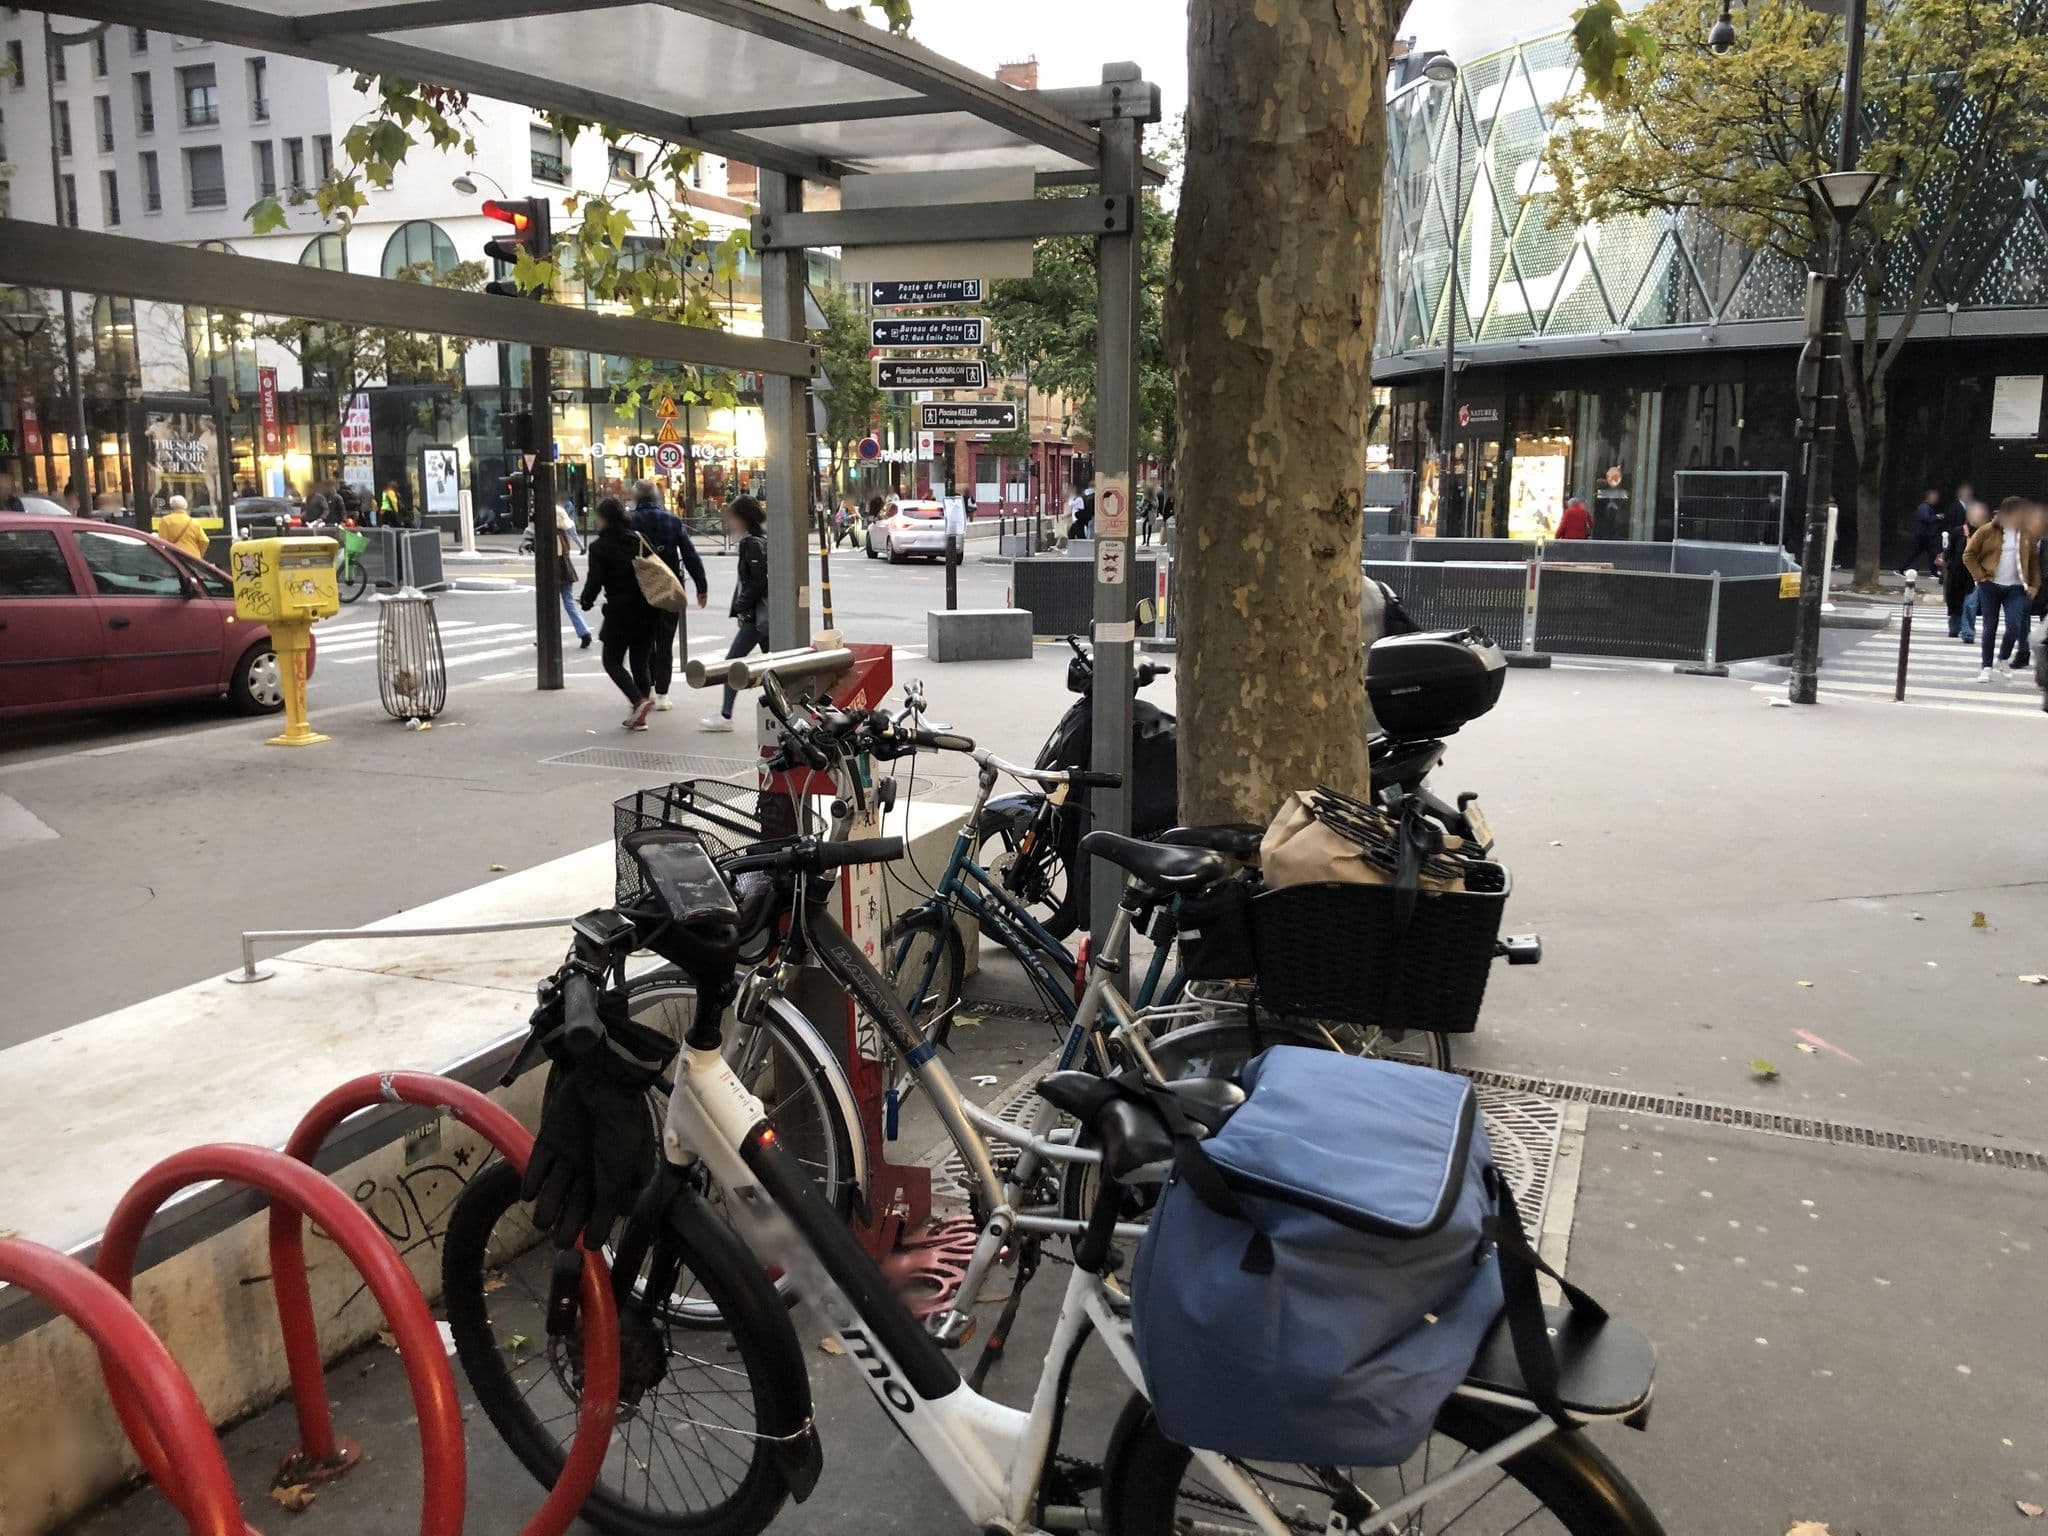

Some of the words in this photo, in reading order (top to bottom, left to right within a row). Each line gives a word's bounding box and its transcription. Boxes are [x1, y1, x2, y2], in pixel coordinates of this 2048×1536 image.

[898, 283, 920, 291] Poste
[924, 282, 933, 290] de
[937, 281, 962, 289] Police
[926, 291, 946, 299] Linois
[900, 325, 926, 333] Bureau
[941, 324, 963, 332] Poste
[945, 333, 959, 341] Zola
[895, 366, 916, 374] Piscine
[935, 366, 965, 374] MOURLON
[265, 391, 273, 422] HEMA
[938, 408, 957, 416] Piscine
[957, 408, 978, 416] KELLER
[176, 451, 205, 462] NOIR
[662, 451, 677, 461] 30
[169, 462, 207, 473] BLANC
[830, 945, 915, 1046] BATAVUS
